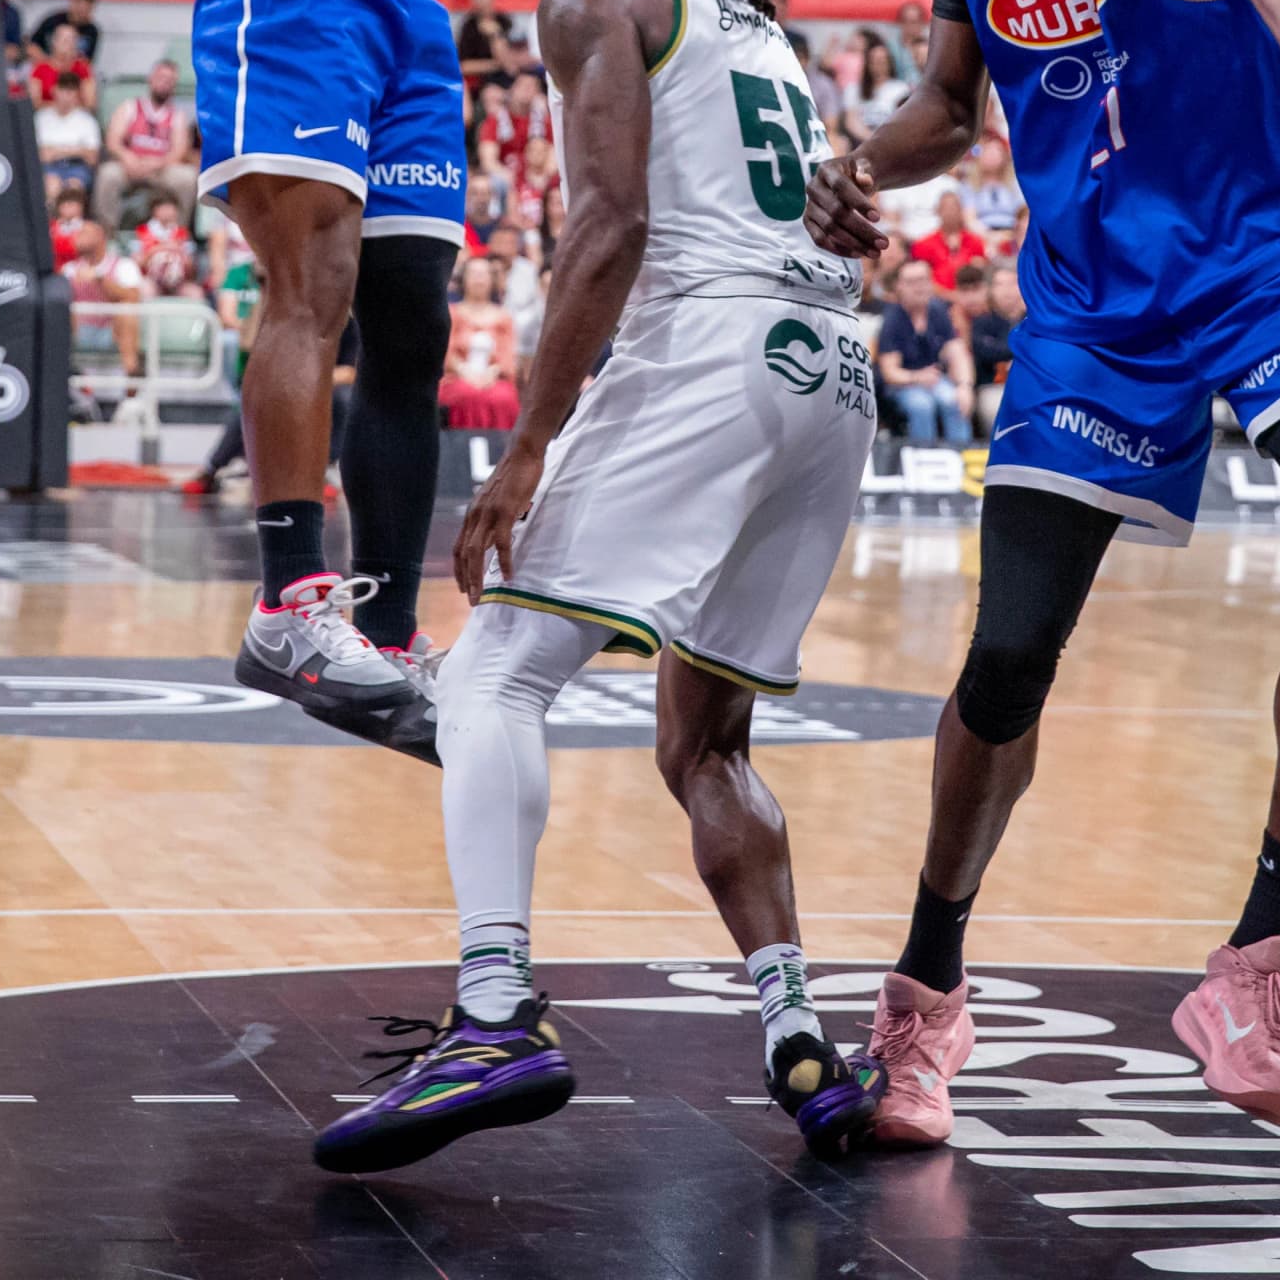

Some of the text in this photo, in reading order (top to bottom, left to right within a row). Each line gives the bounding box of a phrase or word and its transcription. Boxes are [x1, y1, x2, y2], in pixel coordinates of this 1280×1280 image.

[365, 160, 462, 191] NVERSUS
[839, 362, 872, 393] DEL
[835, 387, 874, 420] MÁL
[1052, 404, 1158, 468] INVERSUS
